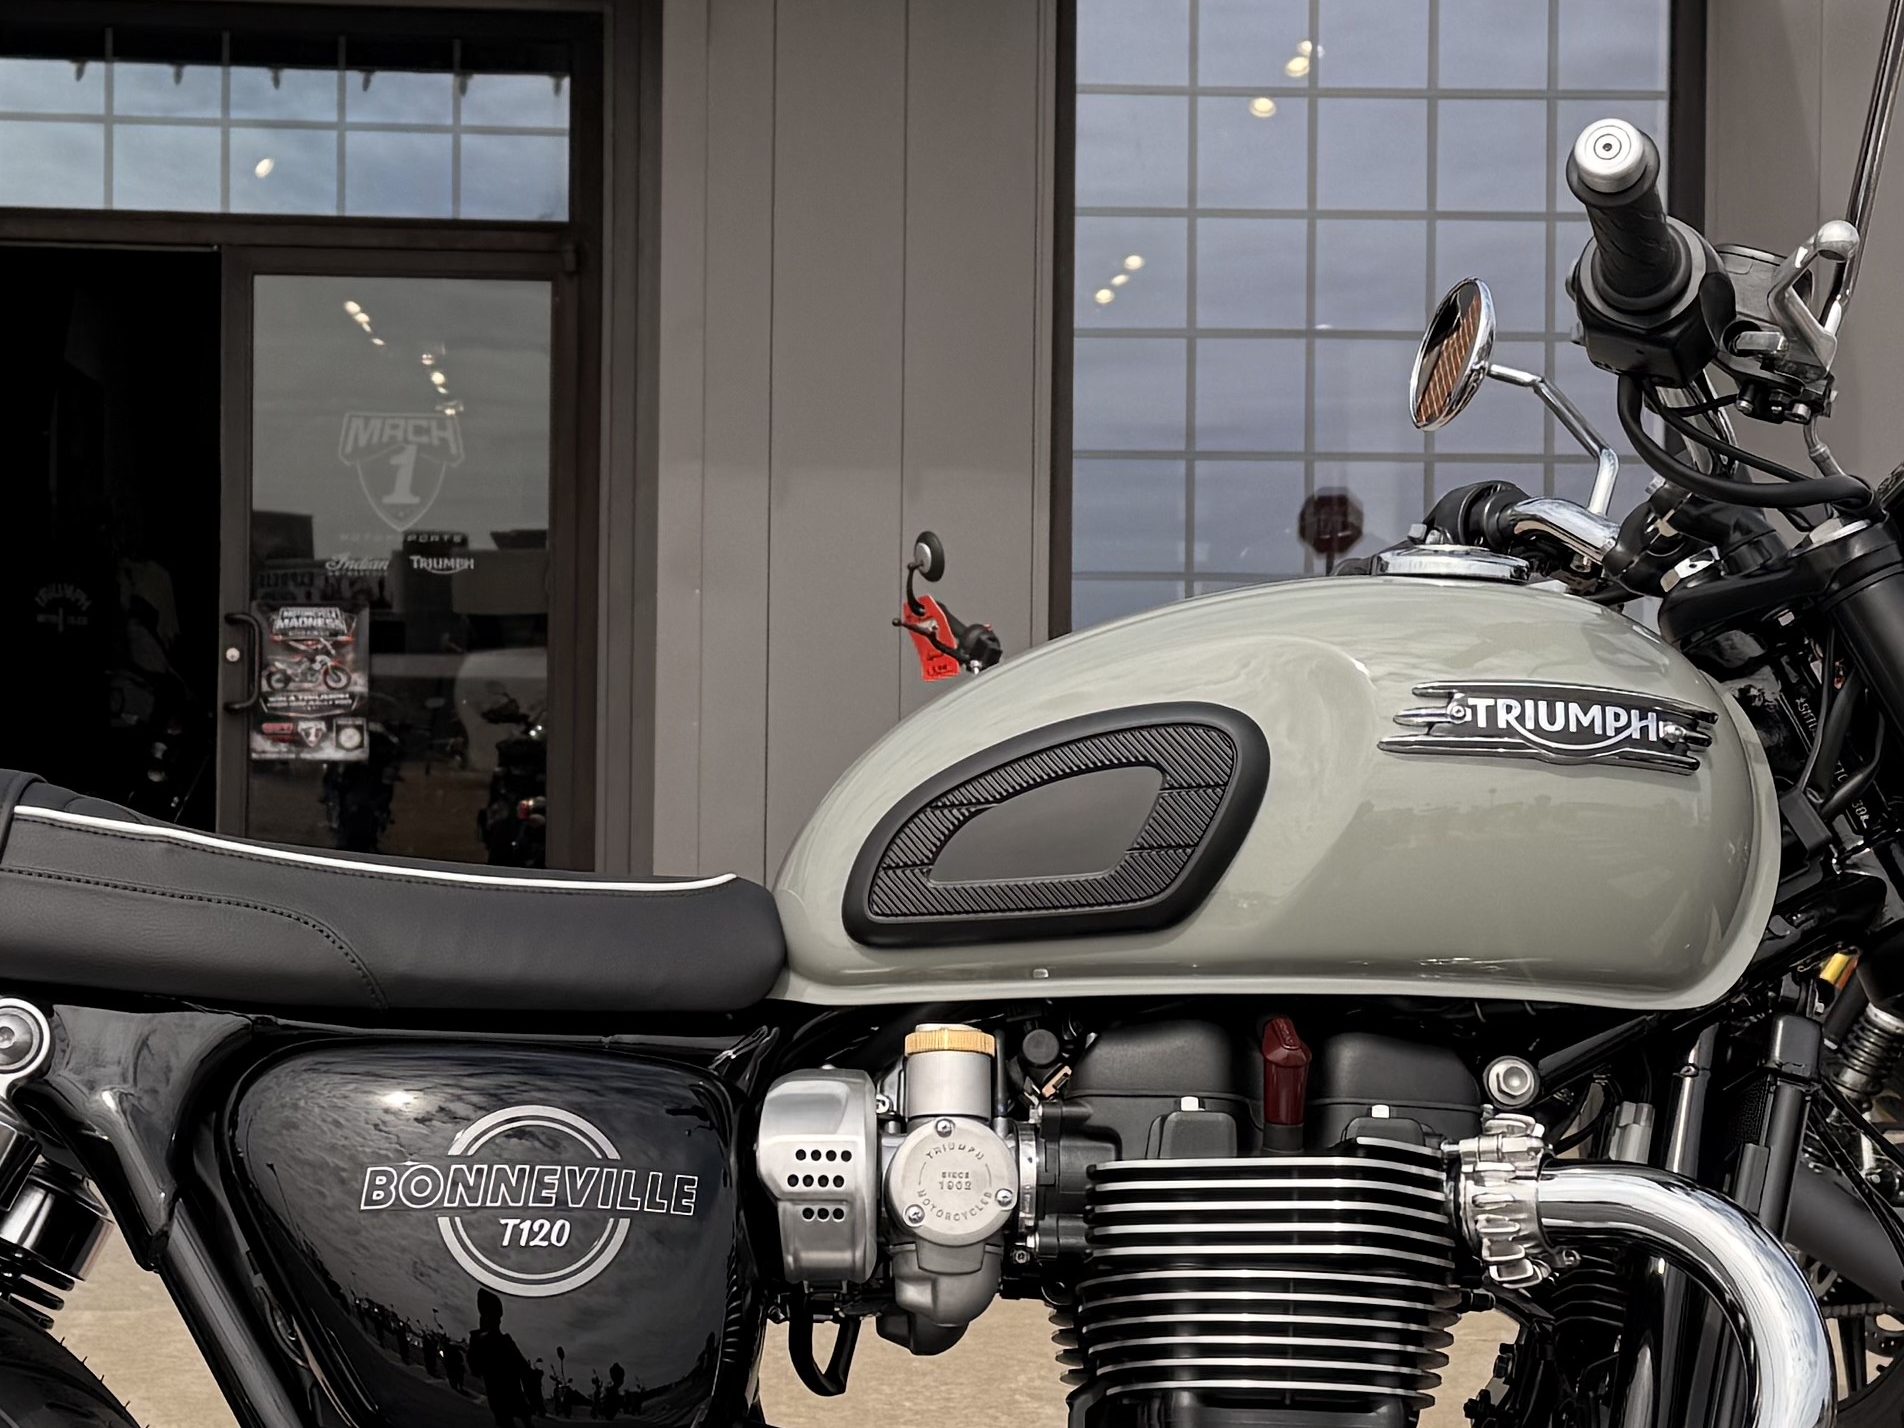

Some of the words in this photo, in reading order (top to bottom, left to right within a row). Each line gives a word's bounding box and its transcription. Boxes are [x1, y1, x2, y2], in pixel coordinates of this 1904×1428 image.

[346, 417, 458, 455] MACH
[381, 444, 421, 504] 1
[325, 552, 390, 570] Indian
[409, 555, 474, 574] TRIUMPH
[1467, 698, 1658, 750] TRIUMPH
[360, 1164, 698, 1215] BONNEVILLE
[938, 1180, 972, 1190] 1902
[499, 1218, 571, 1247] T120
